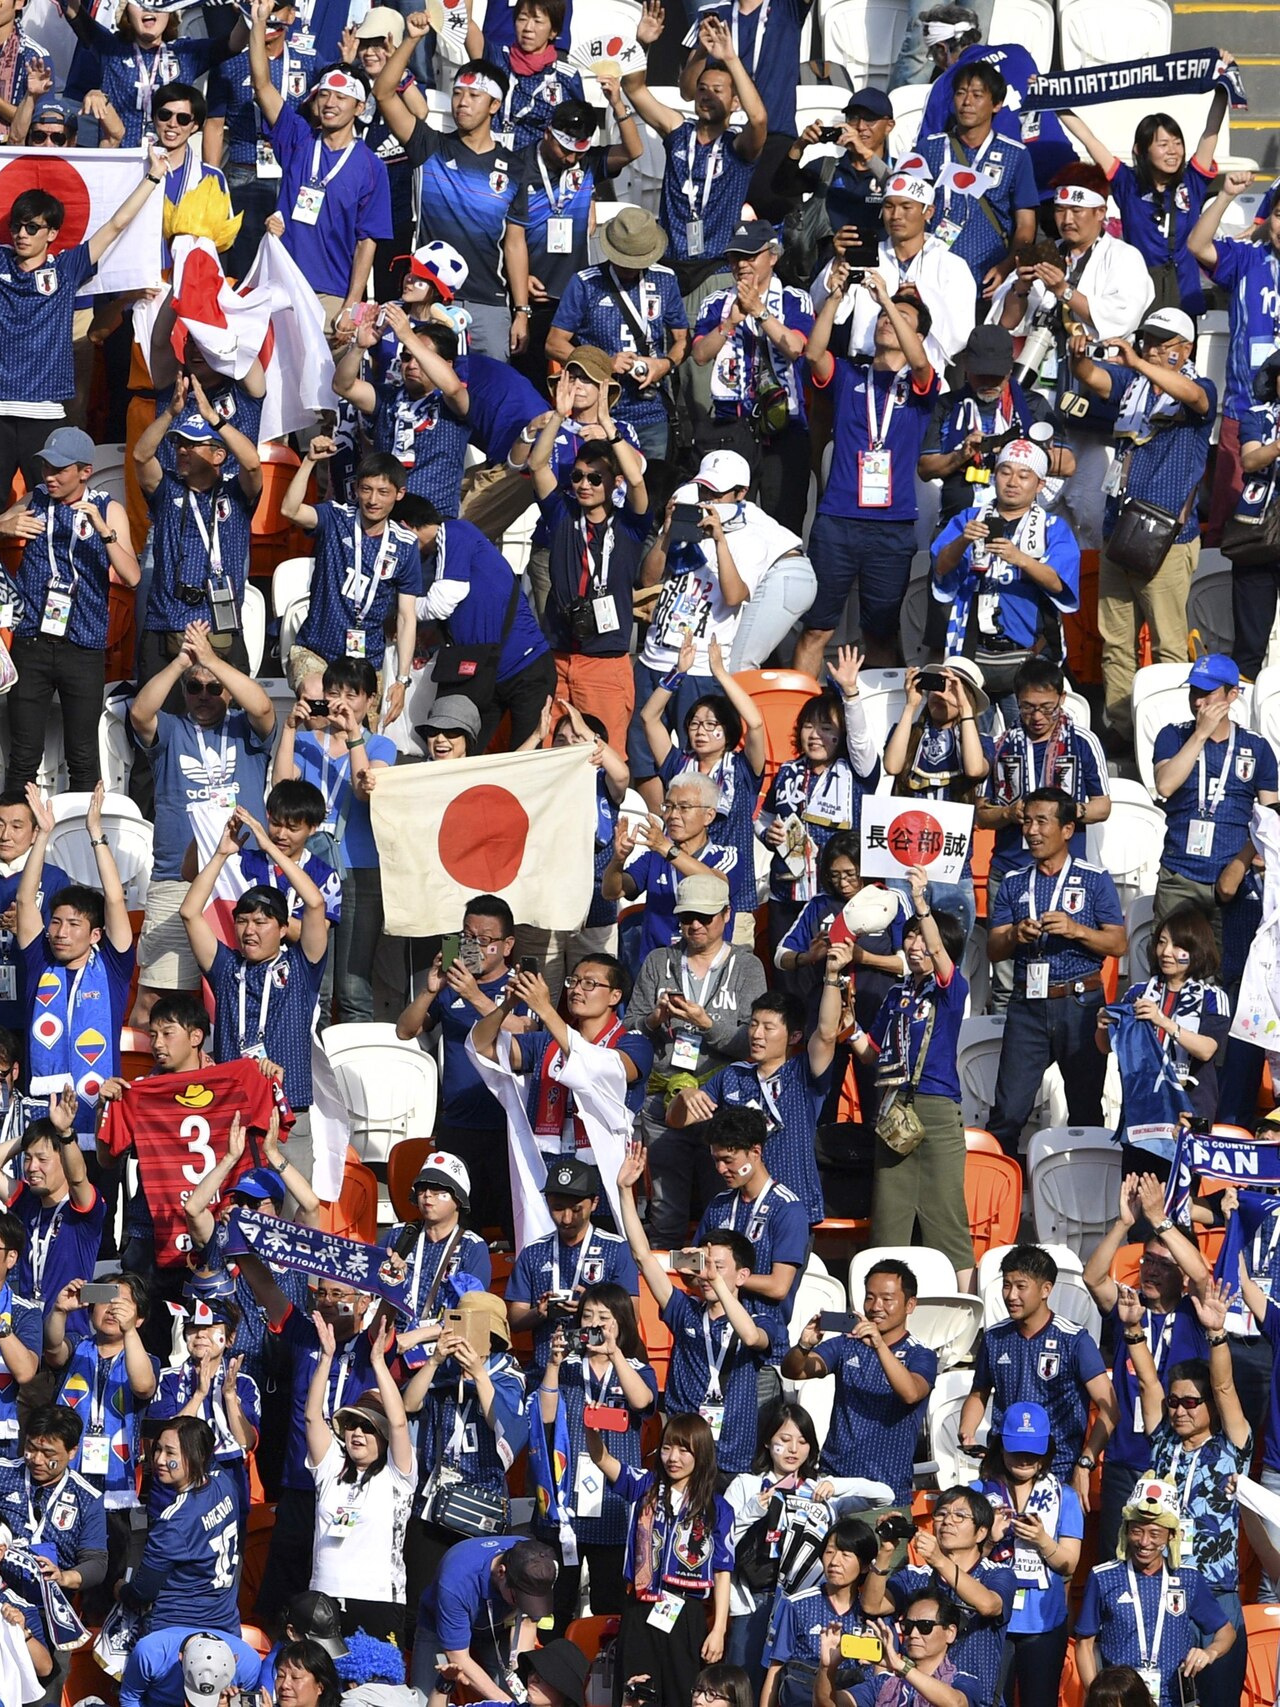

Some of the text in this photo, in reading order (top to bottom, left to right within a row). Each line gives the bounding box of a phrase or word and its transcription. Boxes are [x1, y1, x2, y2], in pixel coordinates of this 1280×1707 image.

[1027, 58, 1211, 96] APAN NATIONAL TEAM
[908, 182, 925, 198] 勝
[1071, 190, 1085, 203] 勝
[186, 783, 240, 801] ads
[866, 825, 967, 858] 長谷部誠
[943, 865, 956, 875] 17
[180, 1115, 217, 1184] 3
[1212, 1140, 1256, 1151] COUNTRY
[240, 1209, 366, 1254] SAMURAI BLUE
[238, 1221, 369, 1279] 日本 代表
[277, 1253, 330, 1274] NATIONAL
[335, 1268, 362, 1284] TEAM
